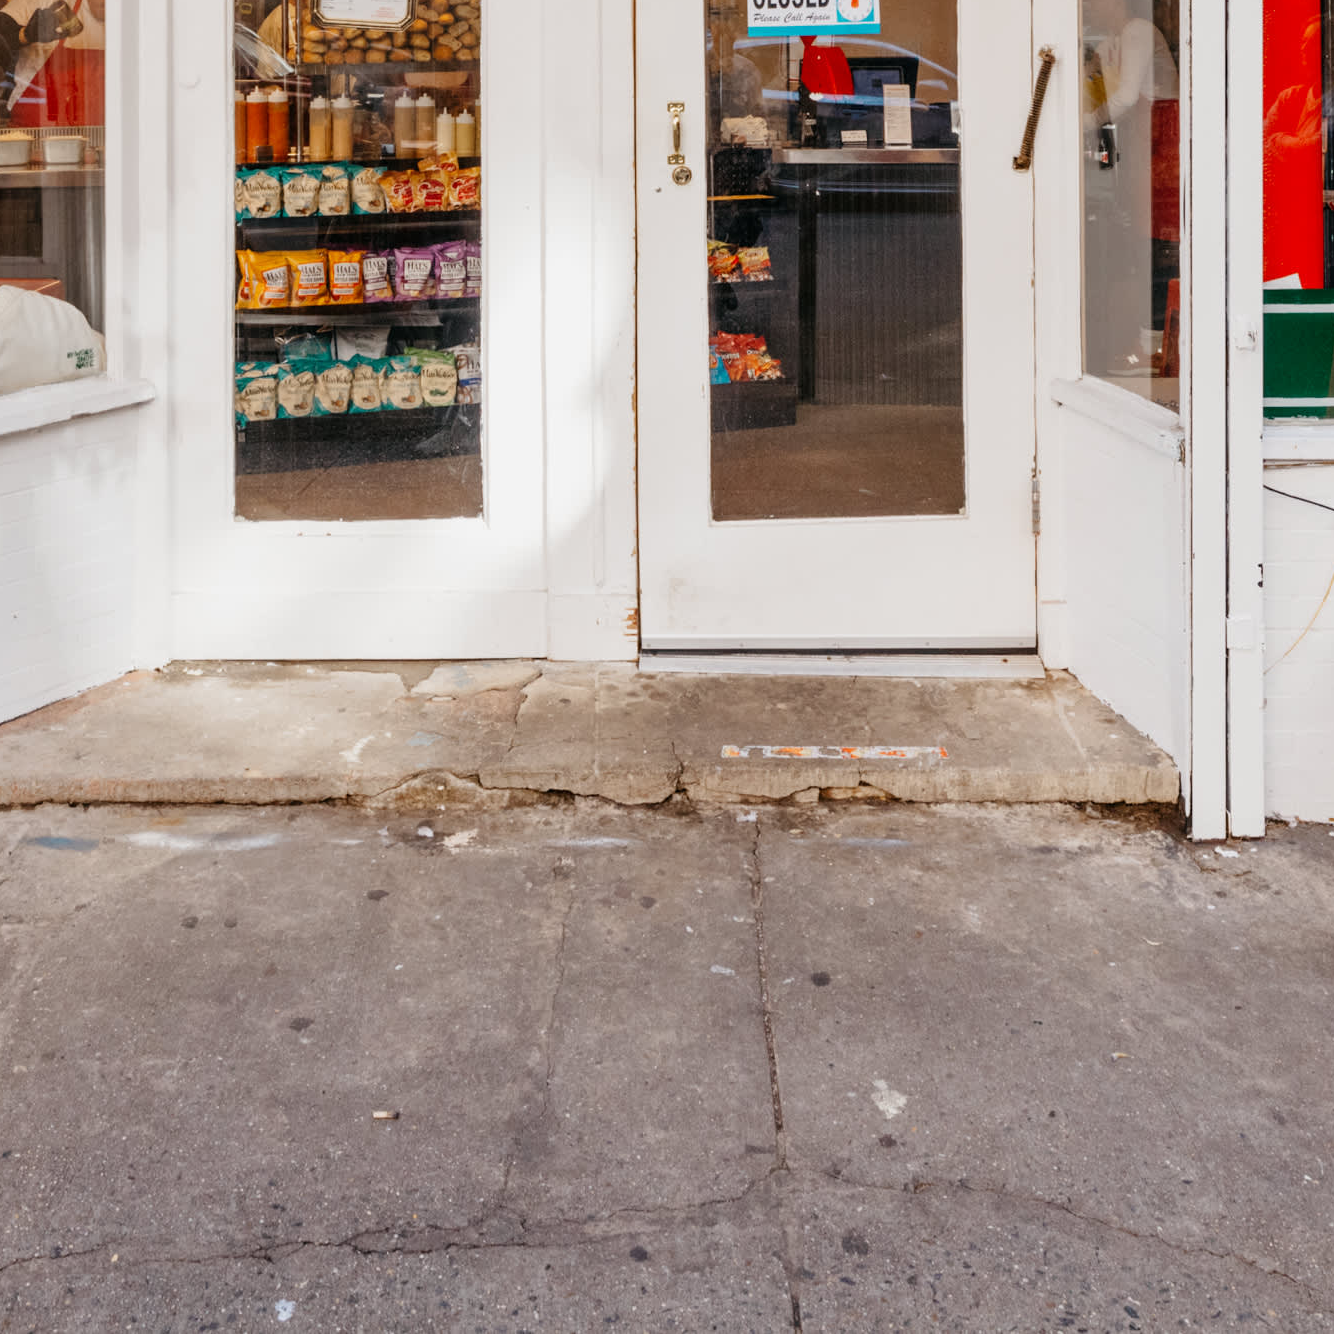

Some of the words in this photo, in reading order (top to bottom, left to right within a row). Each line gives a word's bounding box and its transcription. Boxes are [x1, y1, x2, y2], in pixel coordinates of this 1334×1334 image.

[753, 13, 780, 23] Please
[784, 13, 803, 23] Call
[804, 12, 830, 23] Again
